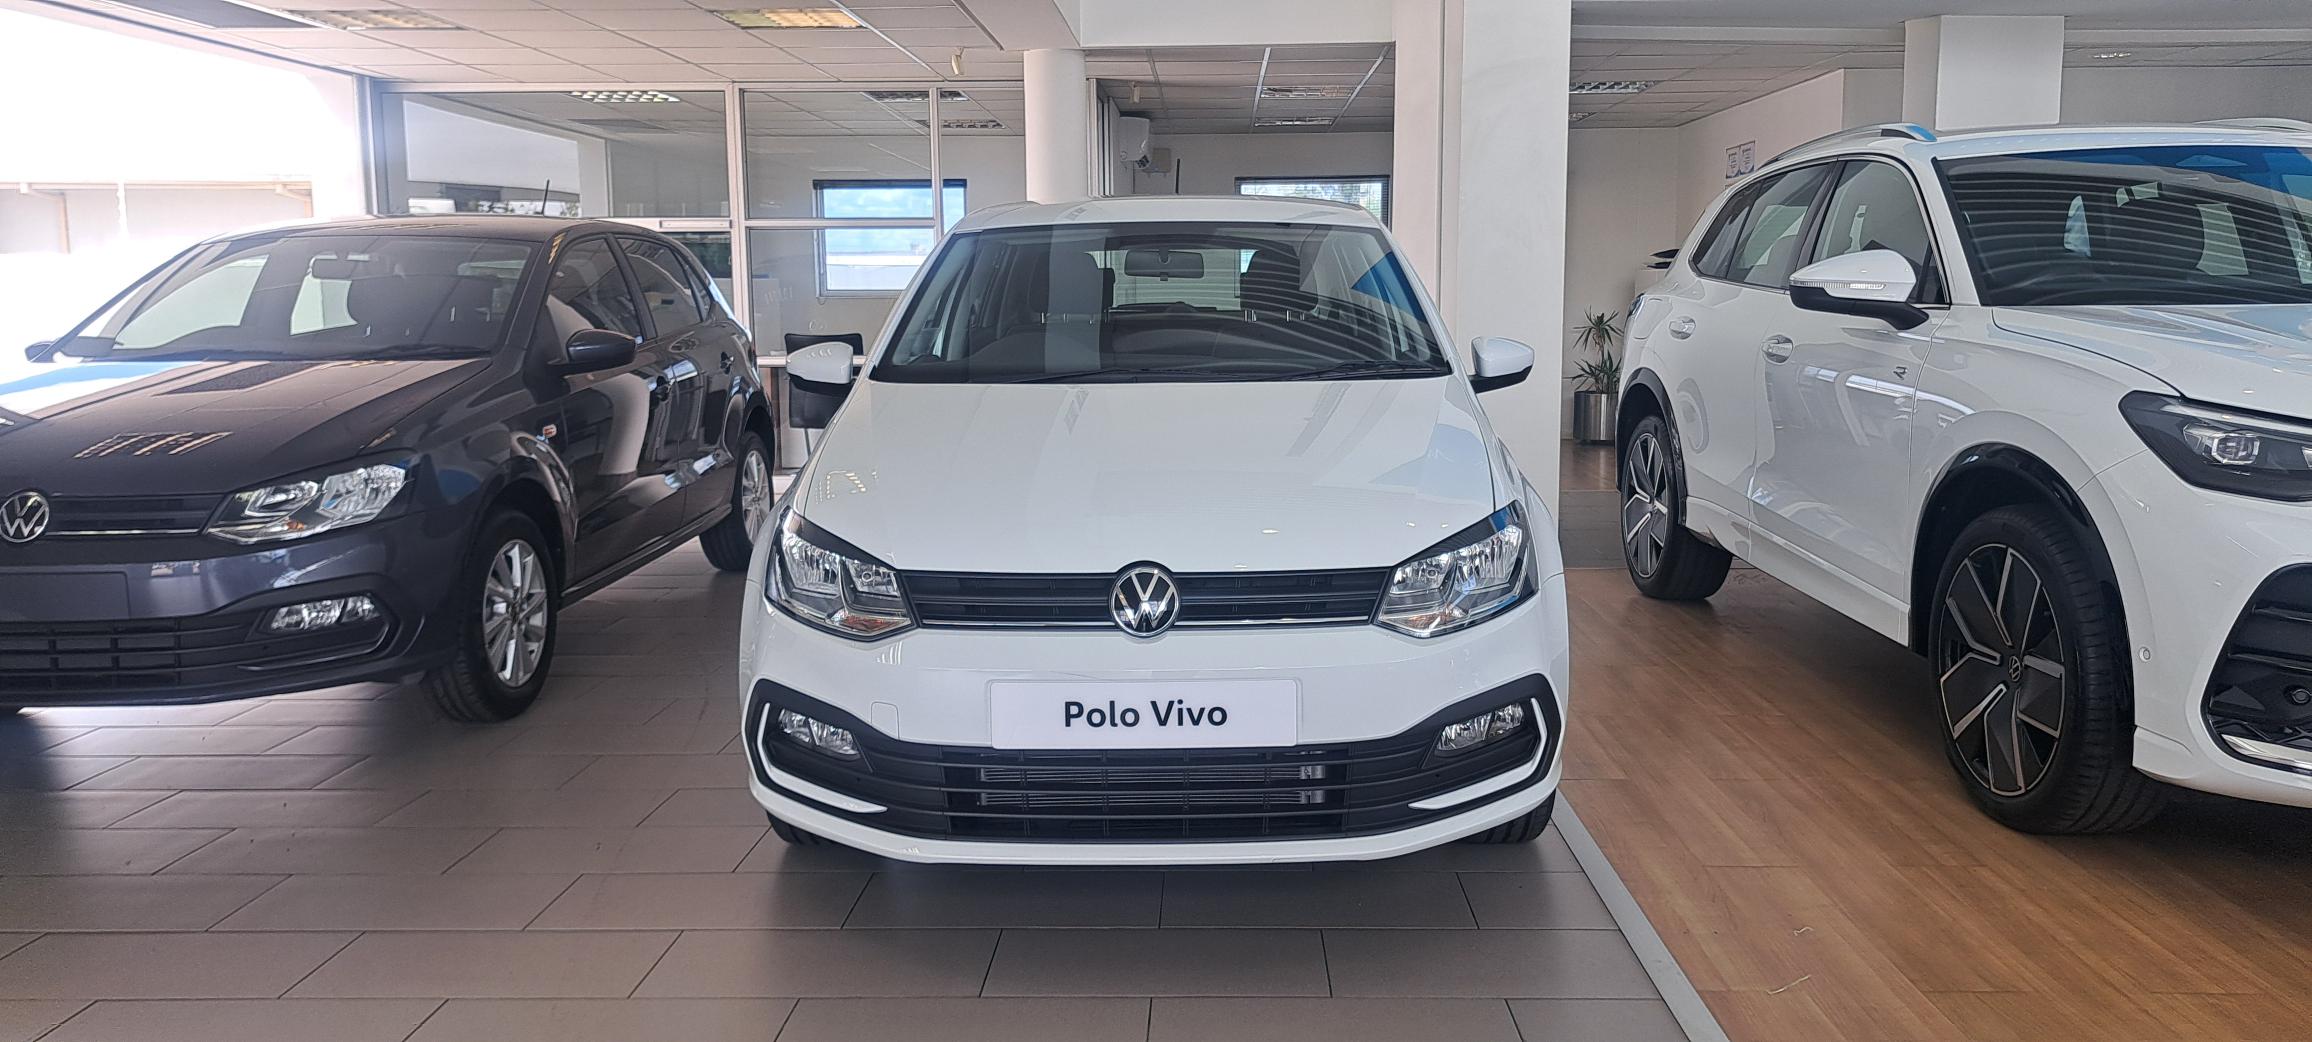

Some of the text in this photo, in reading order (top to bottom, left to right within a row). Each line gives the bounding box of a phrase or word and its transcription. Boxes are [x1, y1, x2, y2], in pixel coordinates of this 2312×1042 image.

[0, 493, 49, 541] VW
[1111, 568, 1177, 633] VW
[1064, 699, 1228, 727] Polo Vivo
